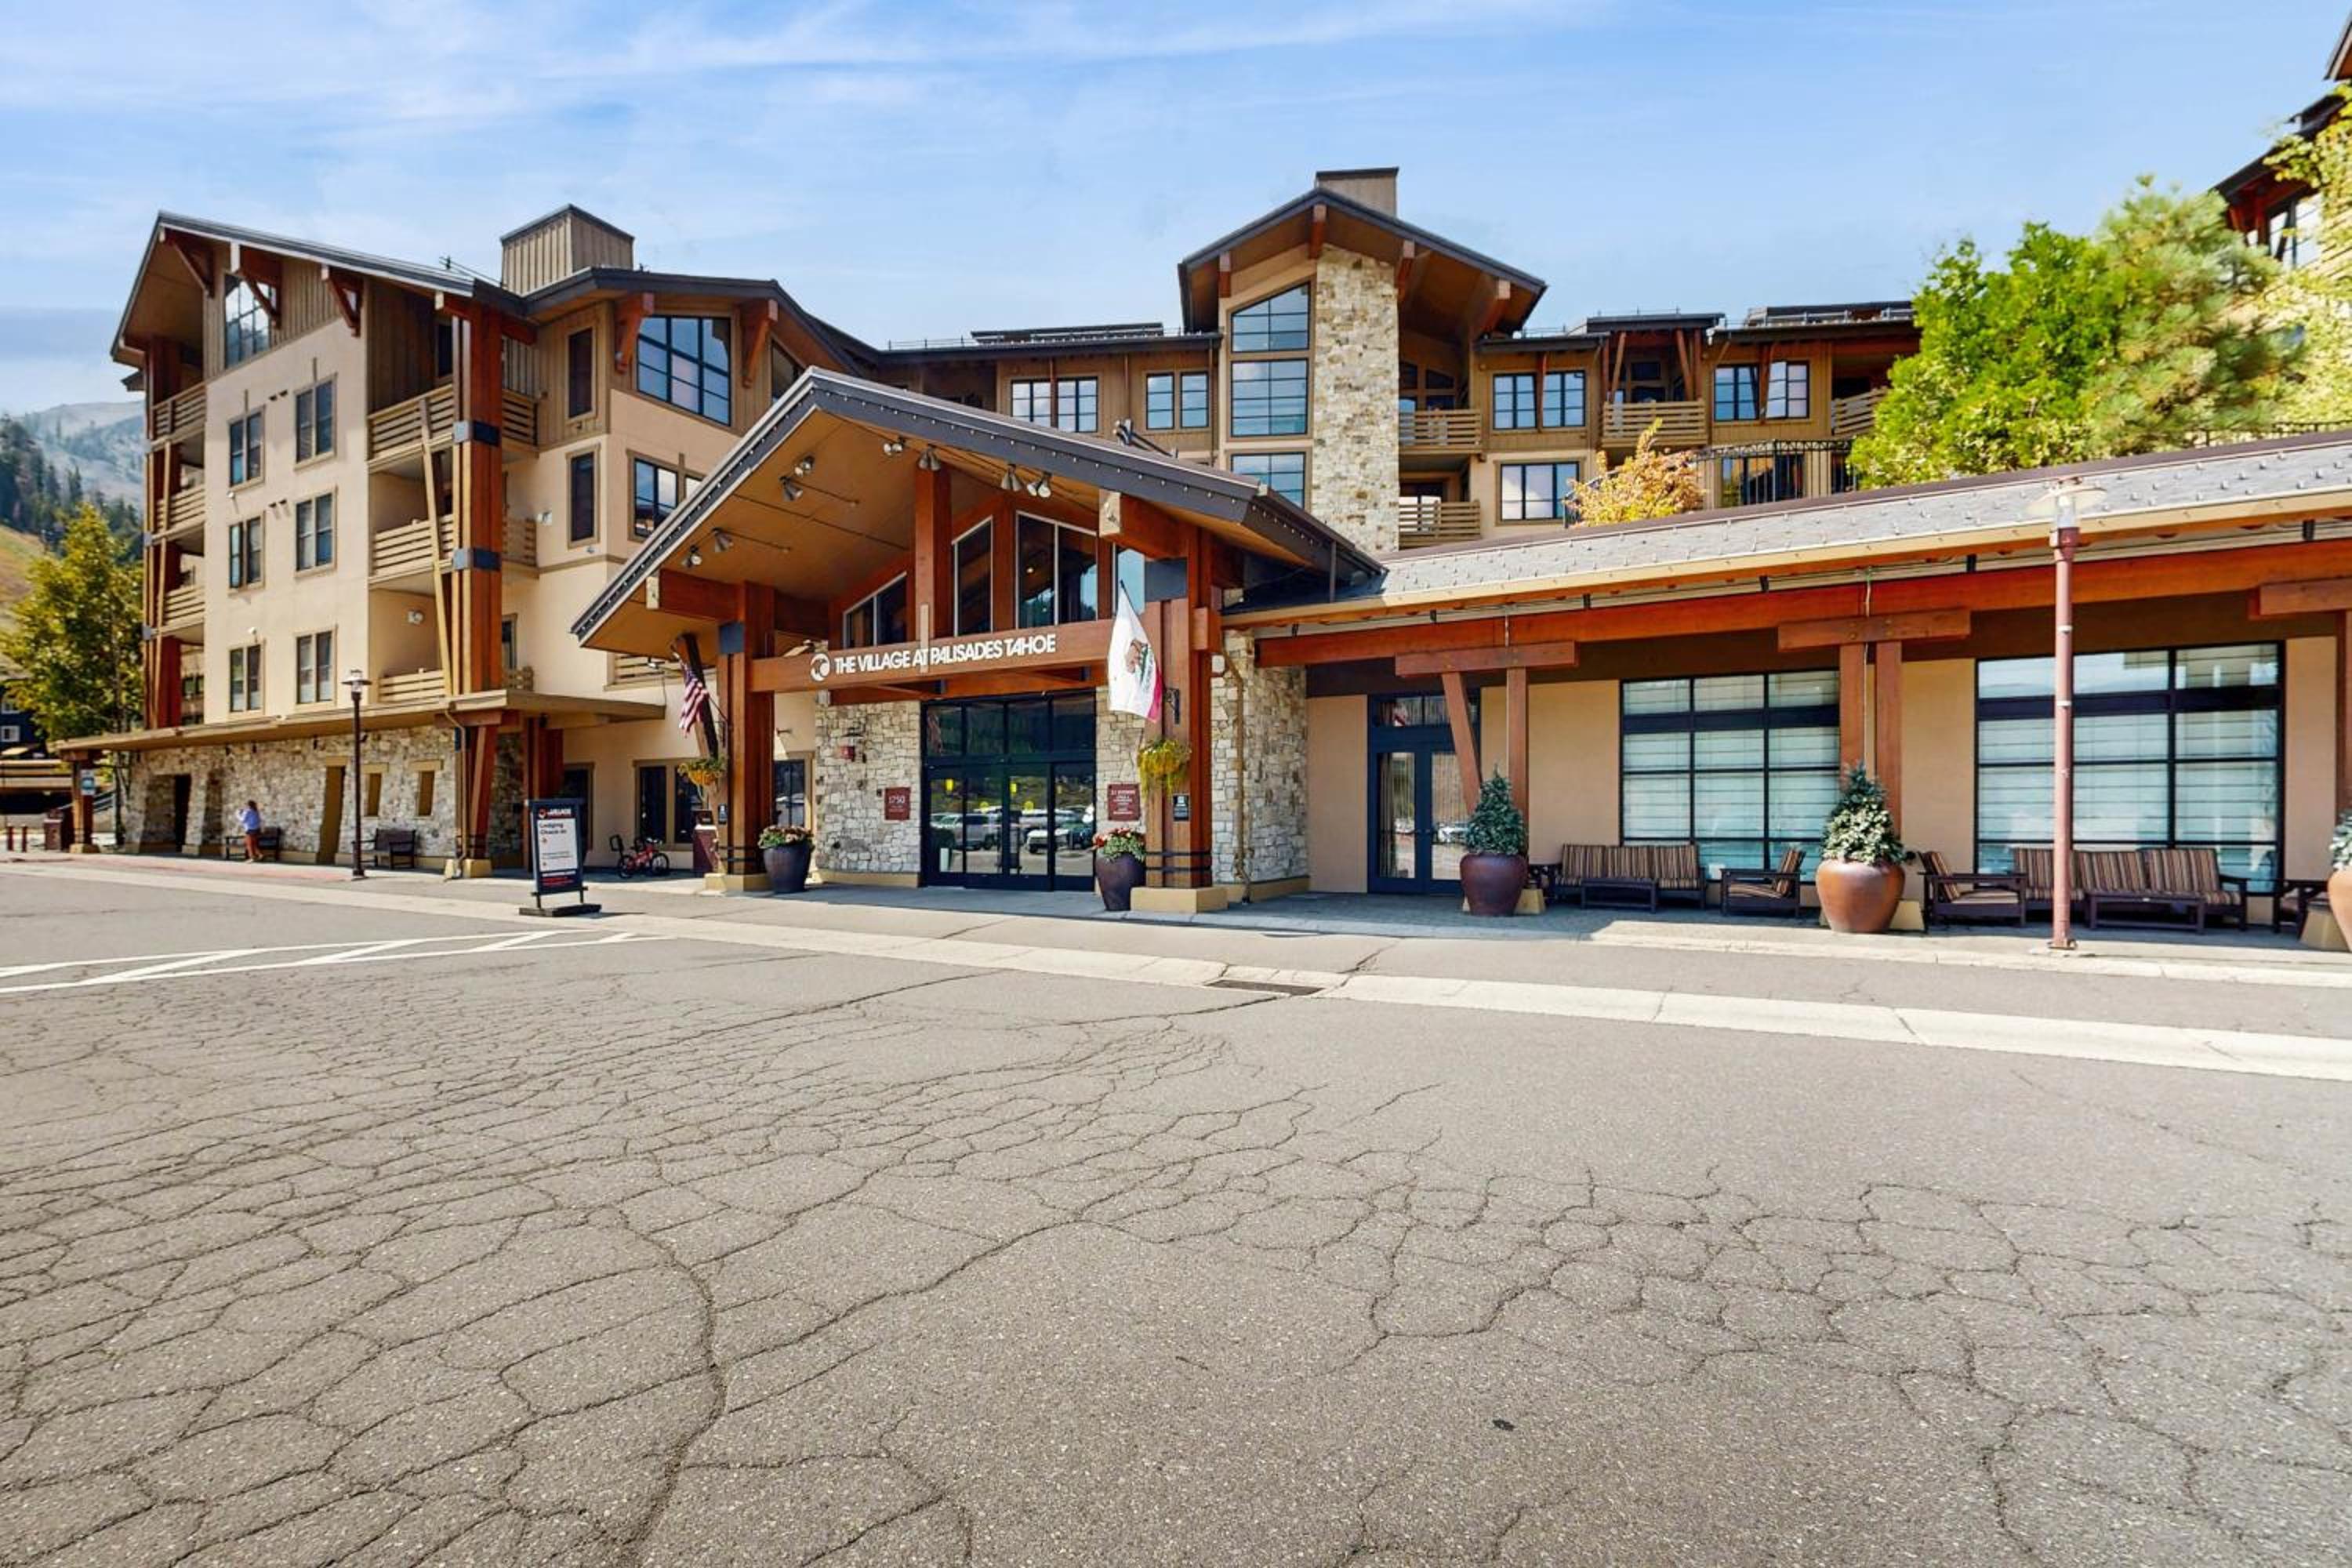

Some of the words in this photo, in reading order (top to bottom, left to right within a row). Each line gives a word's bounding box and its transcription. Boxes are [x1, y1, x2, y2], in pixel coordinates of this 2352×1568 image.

[834, 656, 856, 674] THE
[857, 650, 910, 672] VILLAGE
[912, 648, 928, 666] AT
[931, 640, 1003, 666] PALISADES
[1004, 633, 1056, 656] TAHOE
